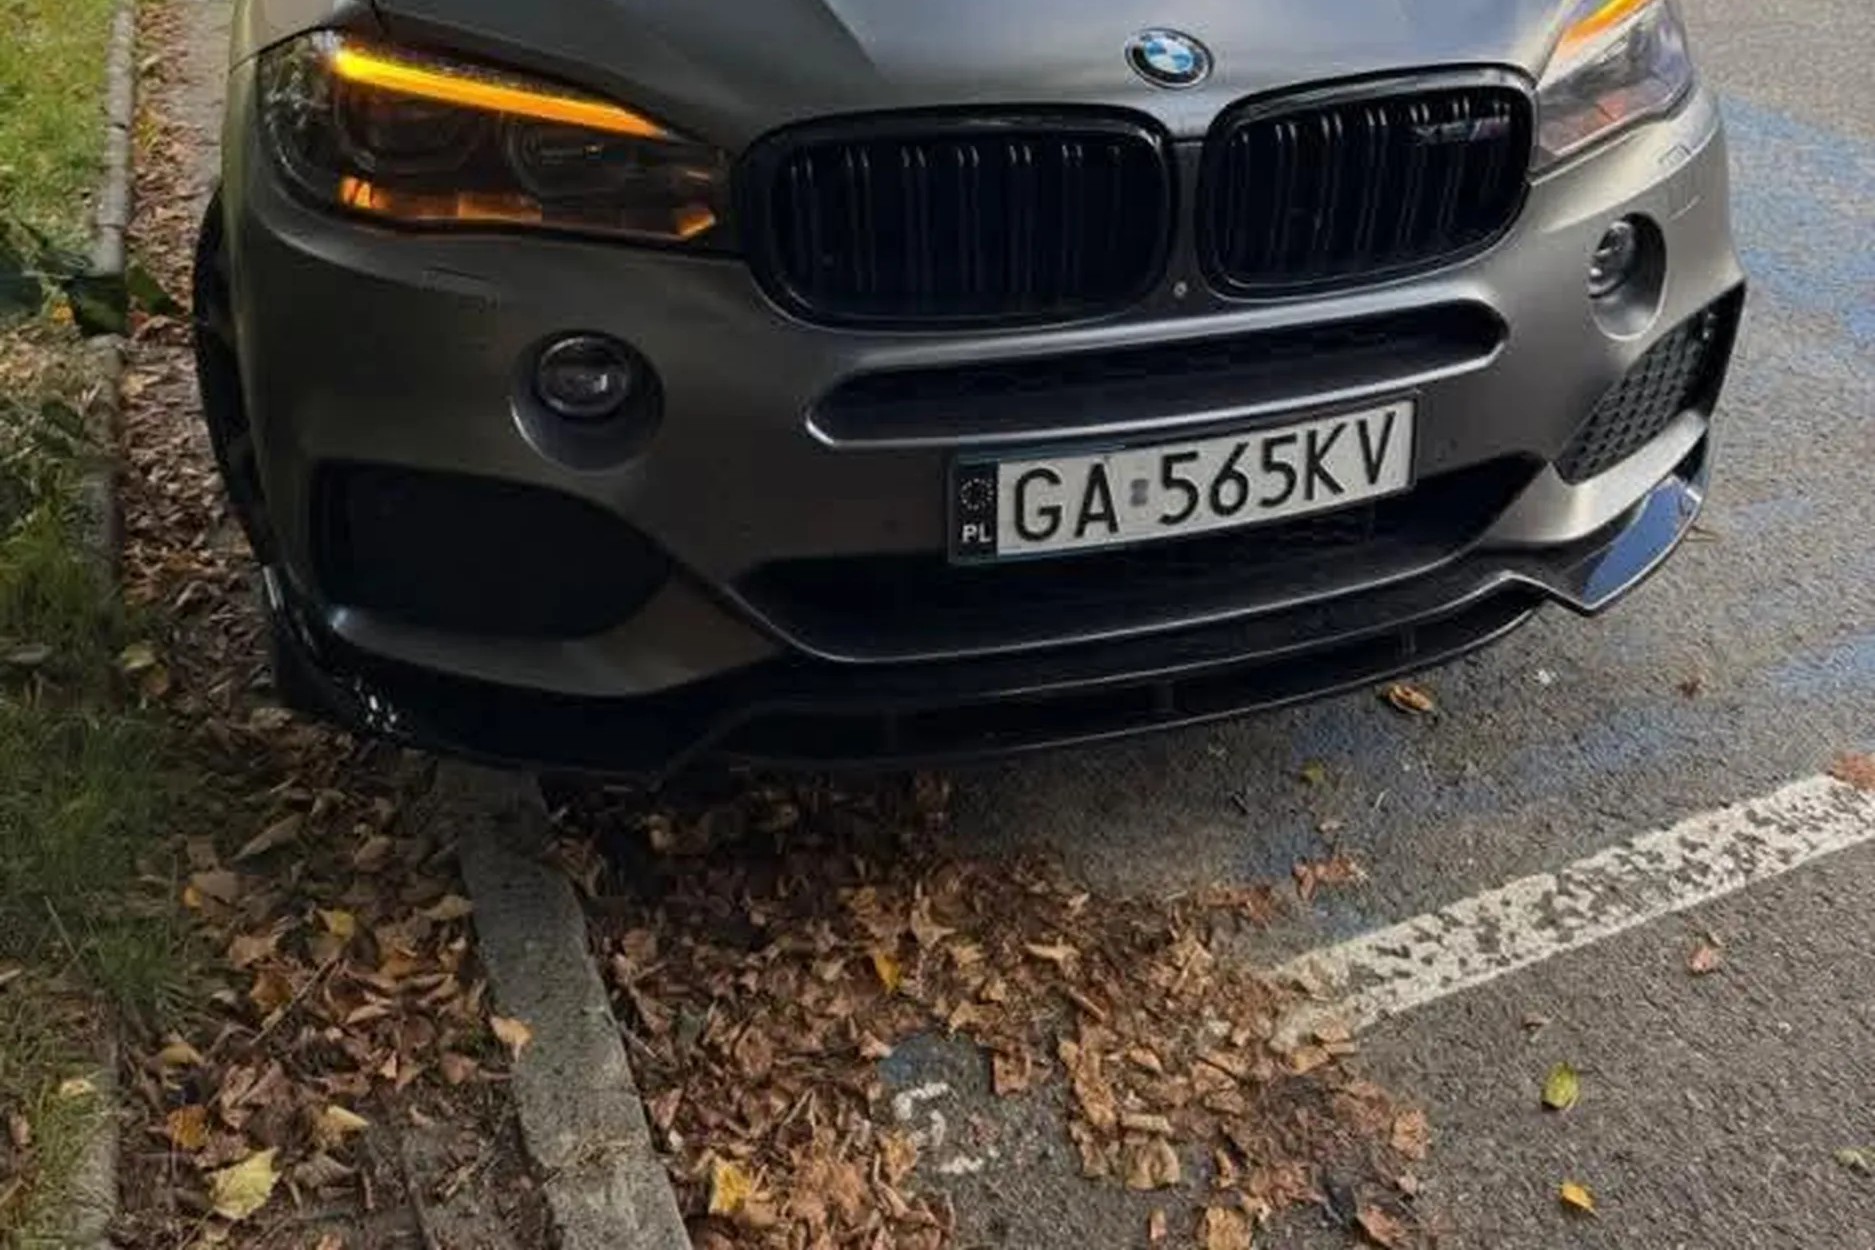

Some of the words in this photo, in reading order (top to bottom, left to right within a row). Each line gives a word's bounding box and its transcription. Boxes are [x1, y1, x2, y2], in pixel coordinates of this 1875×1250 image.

[1014, 463, 1119, 542] GA
[1159, 412, 1396, 526] 565KV
[962, 525, 992, 543] PL
